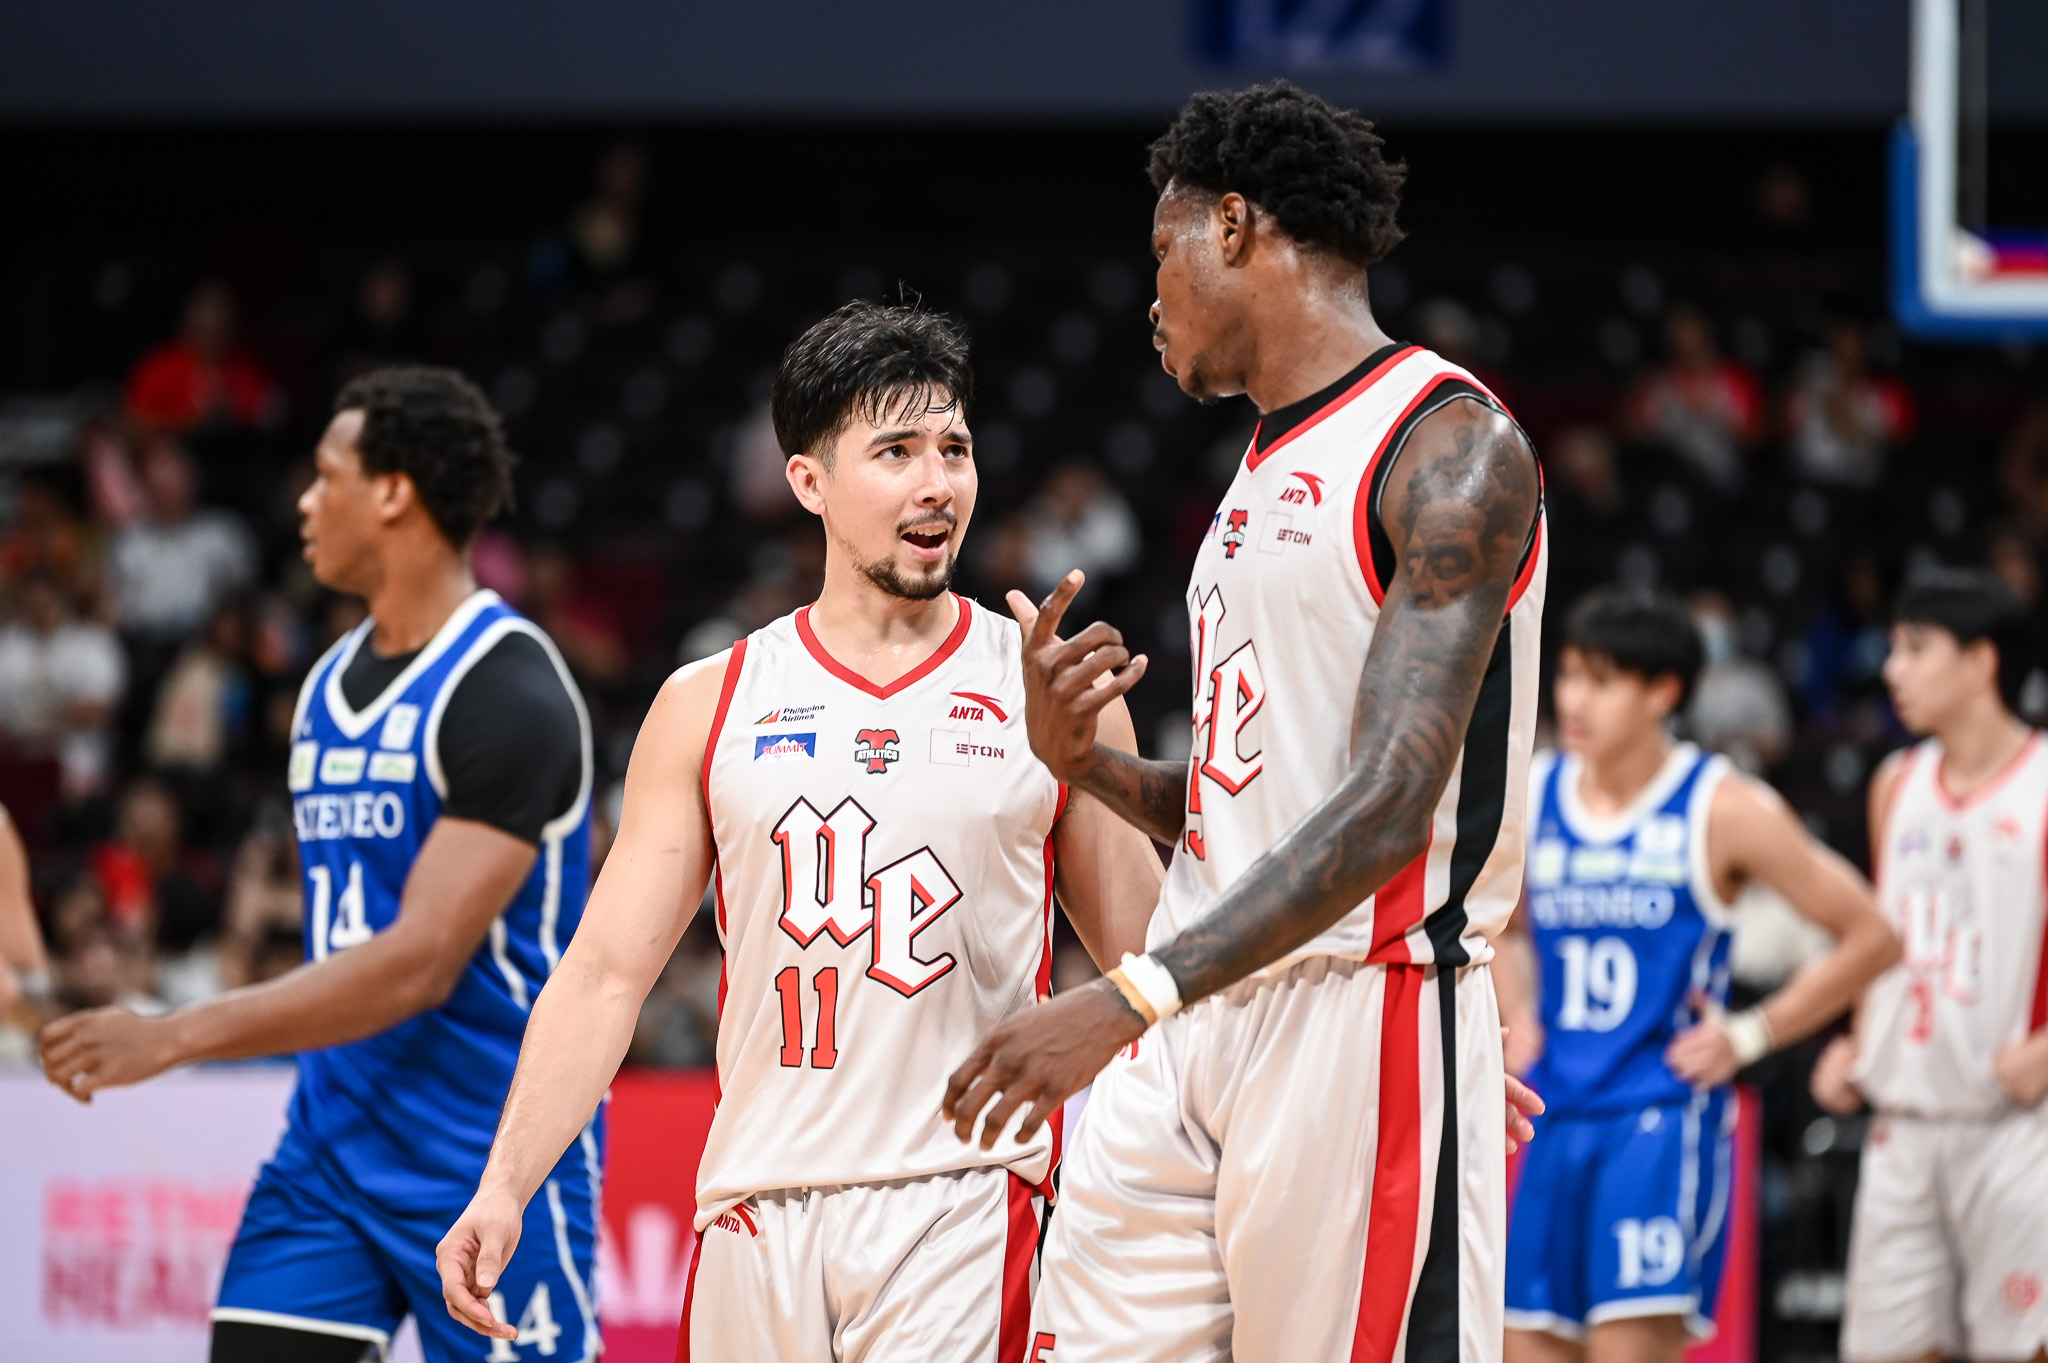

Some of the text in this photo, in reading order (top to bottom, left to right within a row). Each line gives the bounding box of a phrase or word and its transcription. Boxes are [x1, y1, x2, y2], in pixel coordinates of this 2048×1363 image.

[780, 713, 815, 723] Airlines
[783, 704, 826, 715] Philippine
[948, 705, 984, 721] ANTA
[762, 741, 809, 756] SUMMIT
[856, 748, 898, 761] ATHLETICS
[956, 743, 1005, 760] ETON
[308, 860, 374, 963] 14
[1553, 934, 1640, 1033] 19
[775, 966, 838, 1070] 11
[713, 1213, 741, 1235] ANTA
[1610, 1214, 1685, 1290] 19
[484, 1280, 563, 1362] 14
